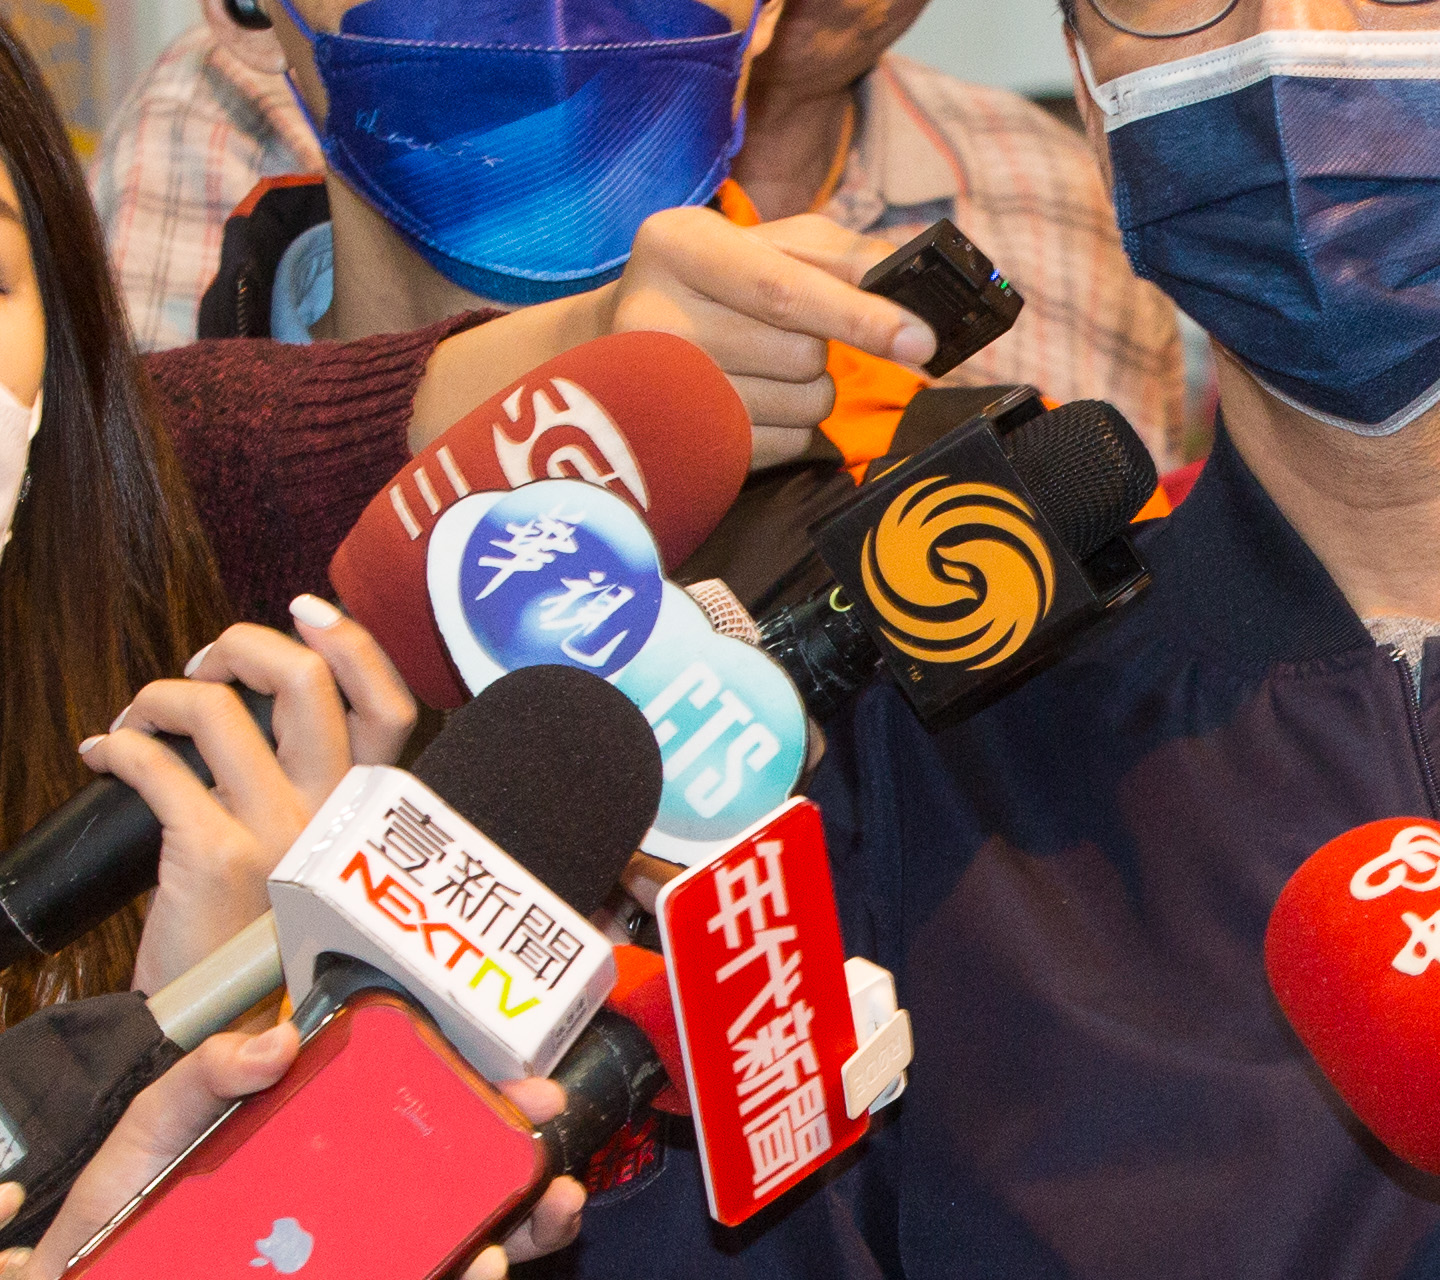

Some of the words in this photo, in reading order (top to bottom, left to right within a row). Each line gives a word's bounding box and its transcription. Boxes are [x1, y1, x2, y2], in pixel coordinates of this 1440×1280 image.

[652, 660, 781, 819] CTS
[366, 796, 585, 991] 壹新聞
[706, 839, 834, 1201] 年代新聞
